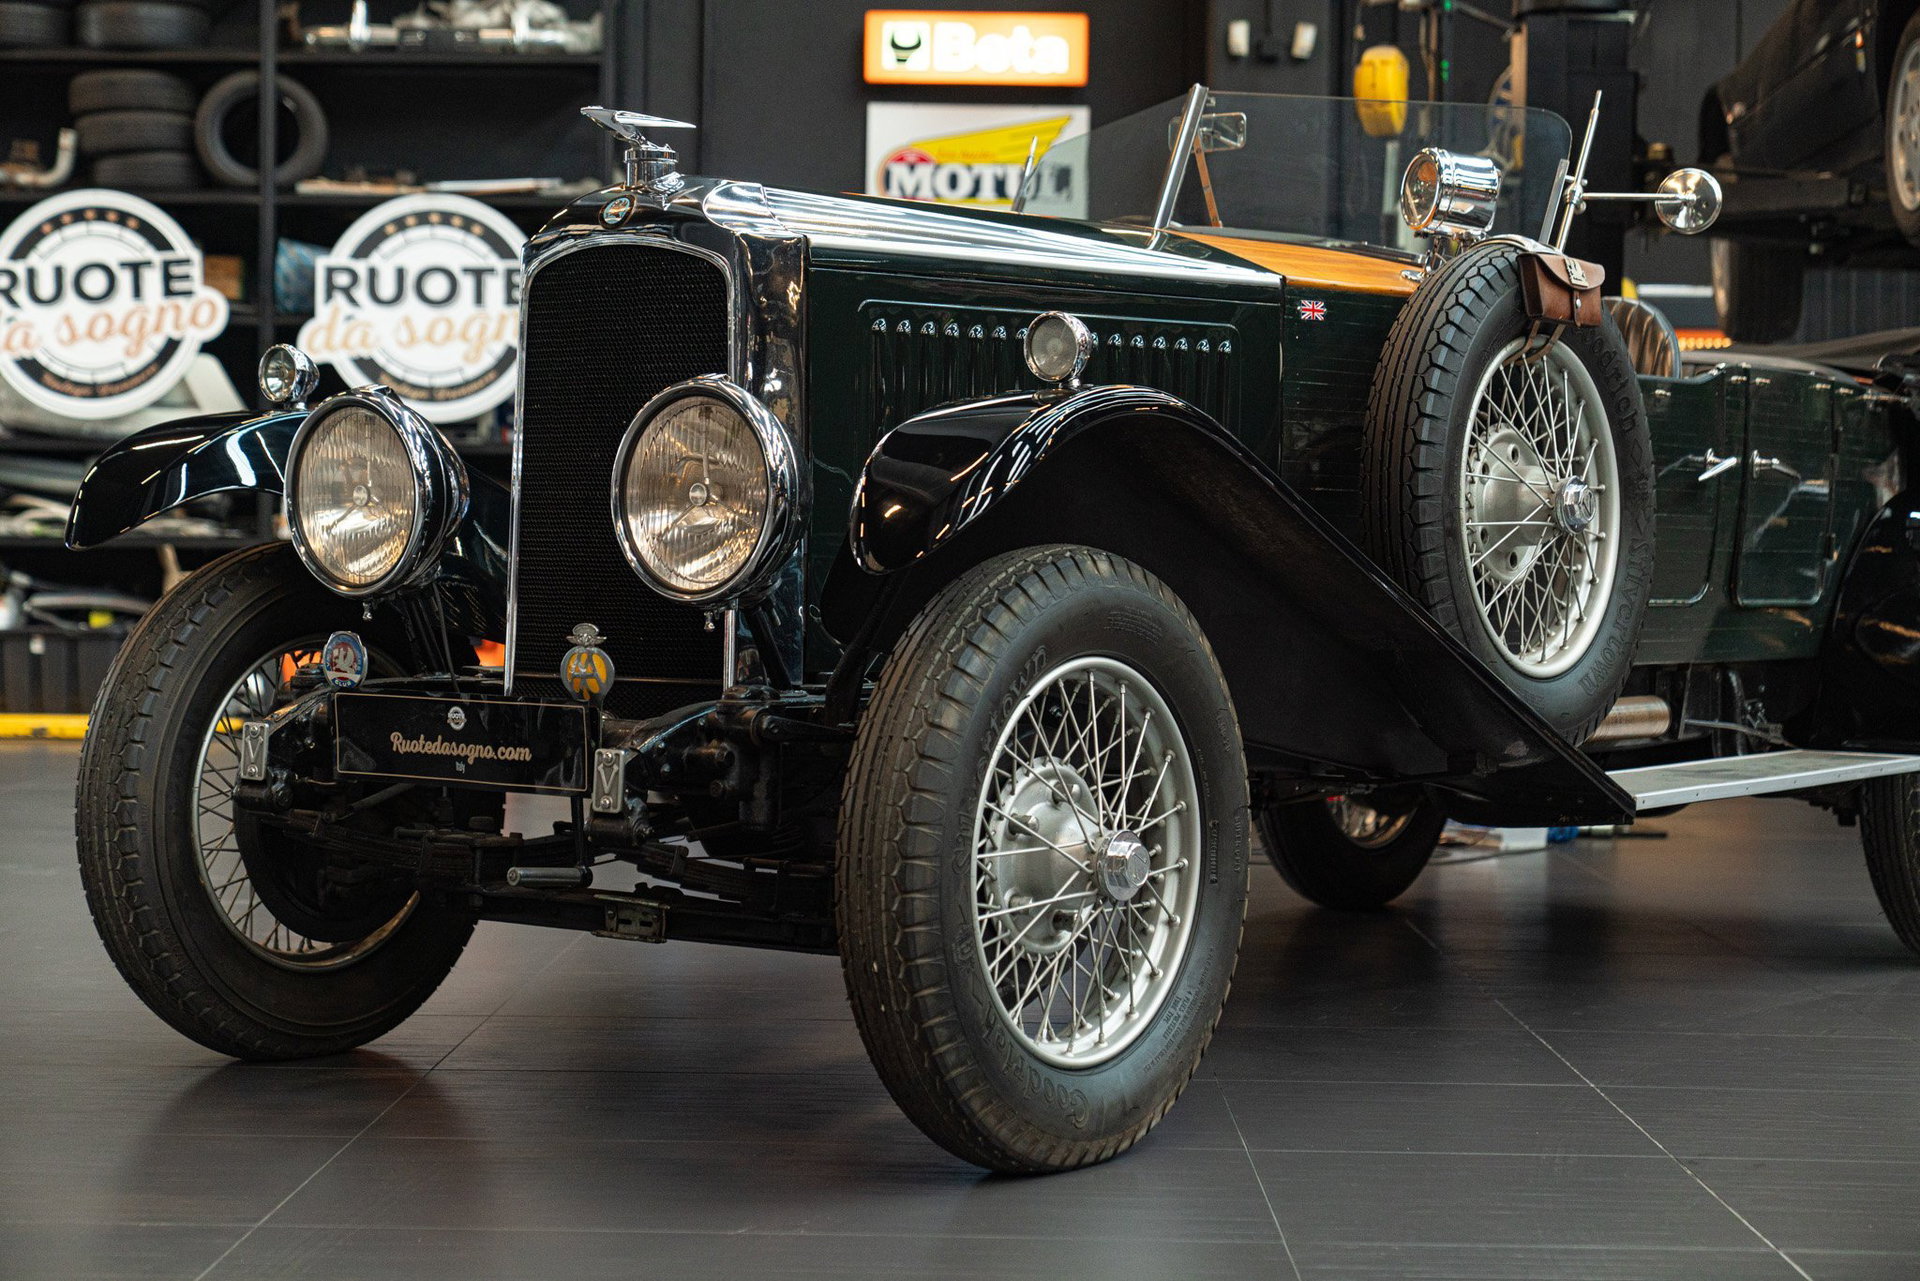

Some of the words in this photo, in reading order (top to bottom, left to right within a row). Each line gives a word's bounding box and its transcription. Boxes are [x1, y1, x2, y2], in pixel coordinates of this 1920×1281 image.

[933, 21, 1069, 74] Beta
[57, 298, 217, 358] sogno
[306, 304, 375, 354] da
[396, 312, 521, 363] sogn
[390, 731, 532, 765] Ruotedasogno.com
